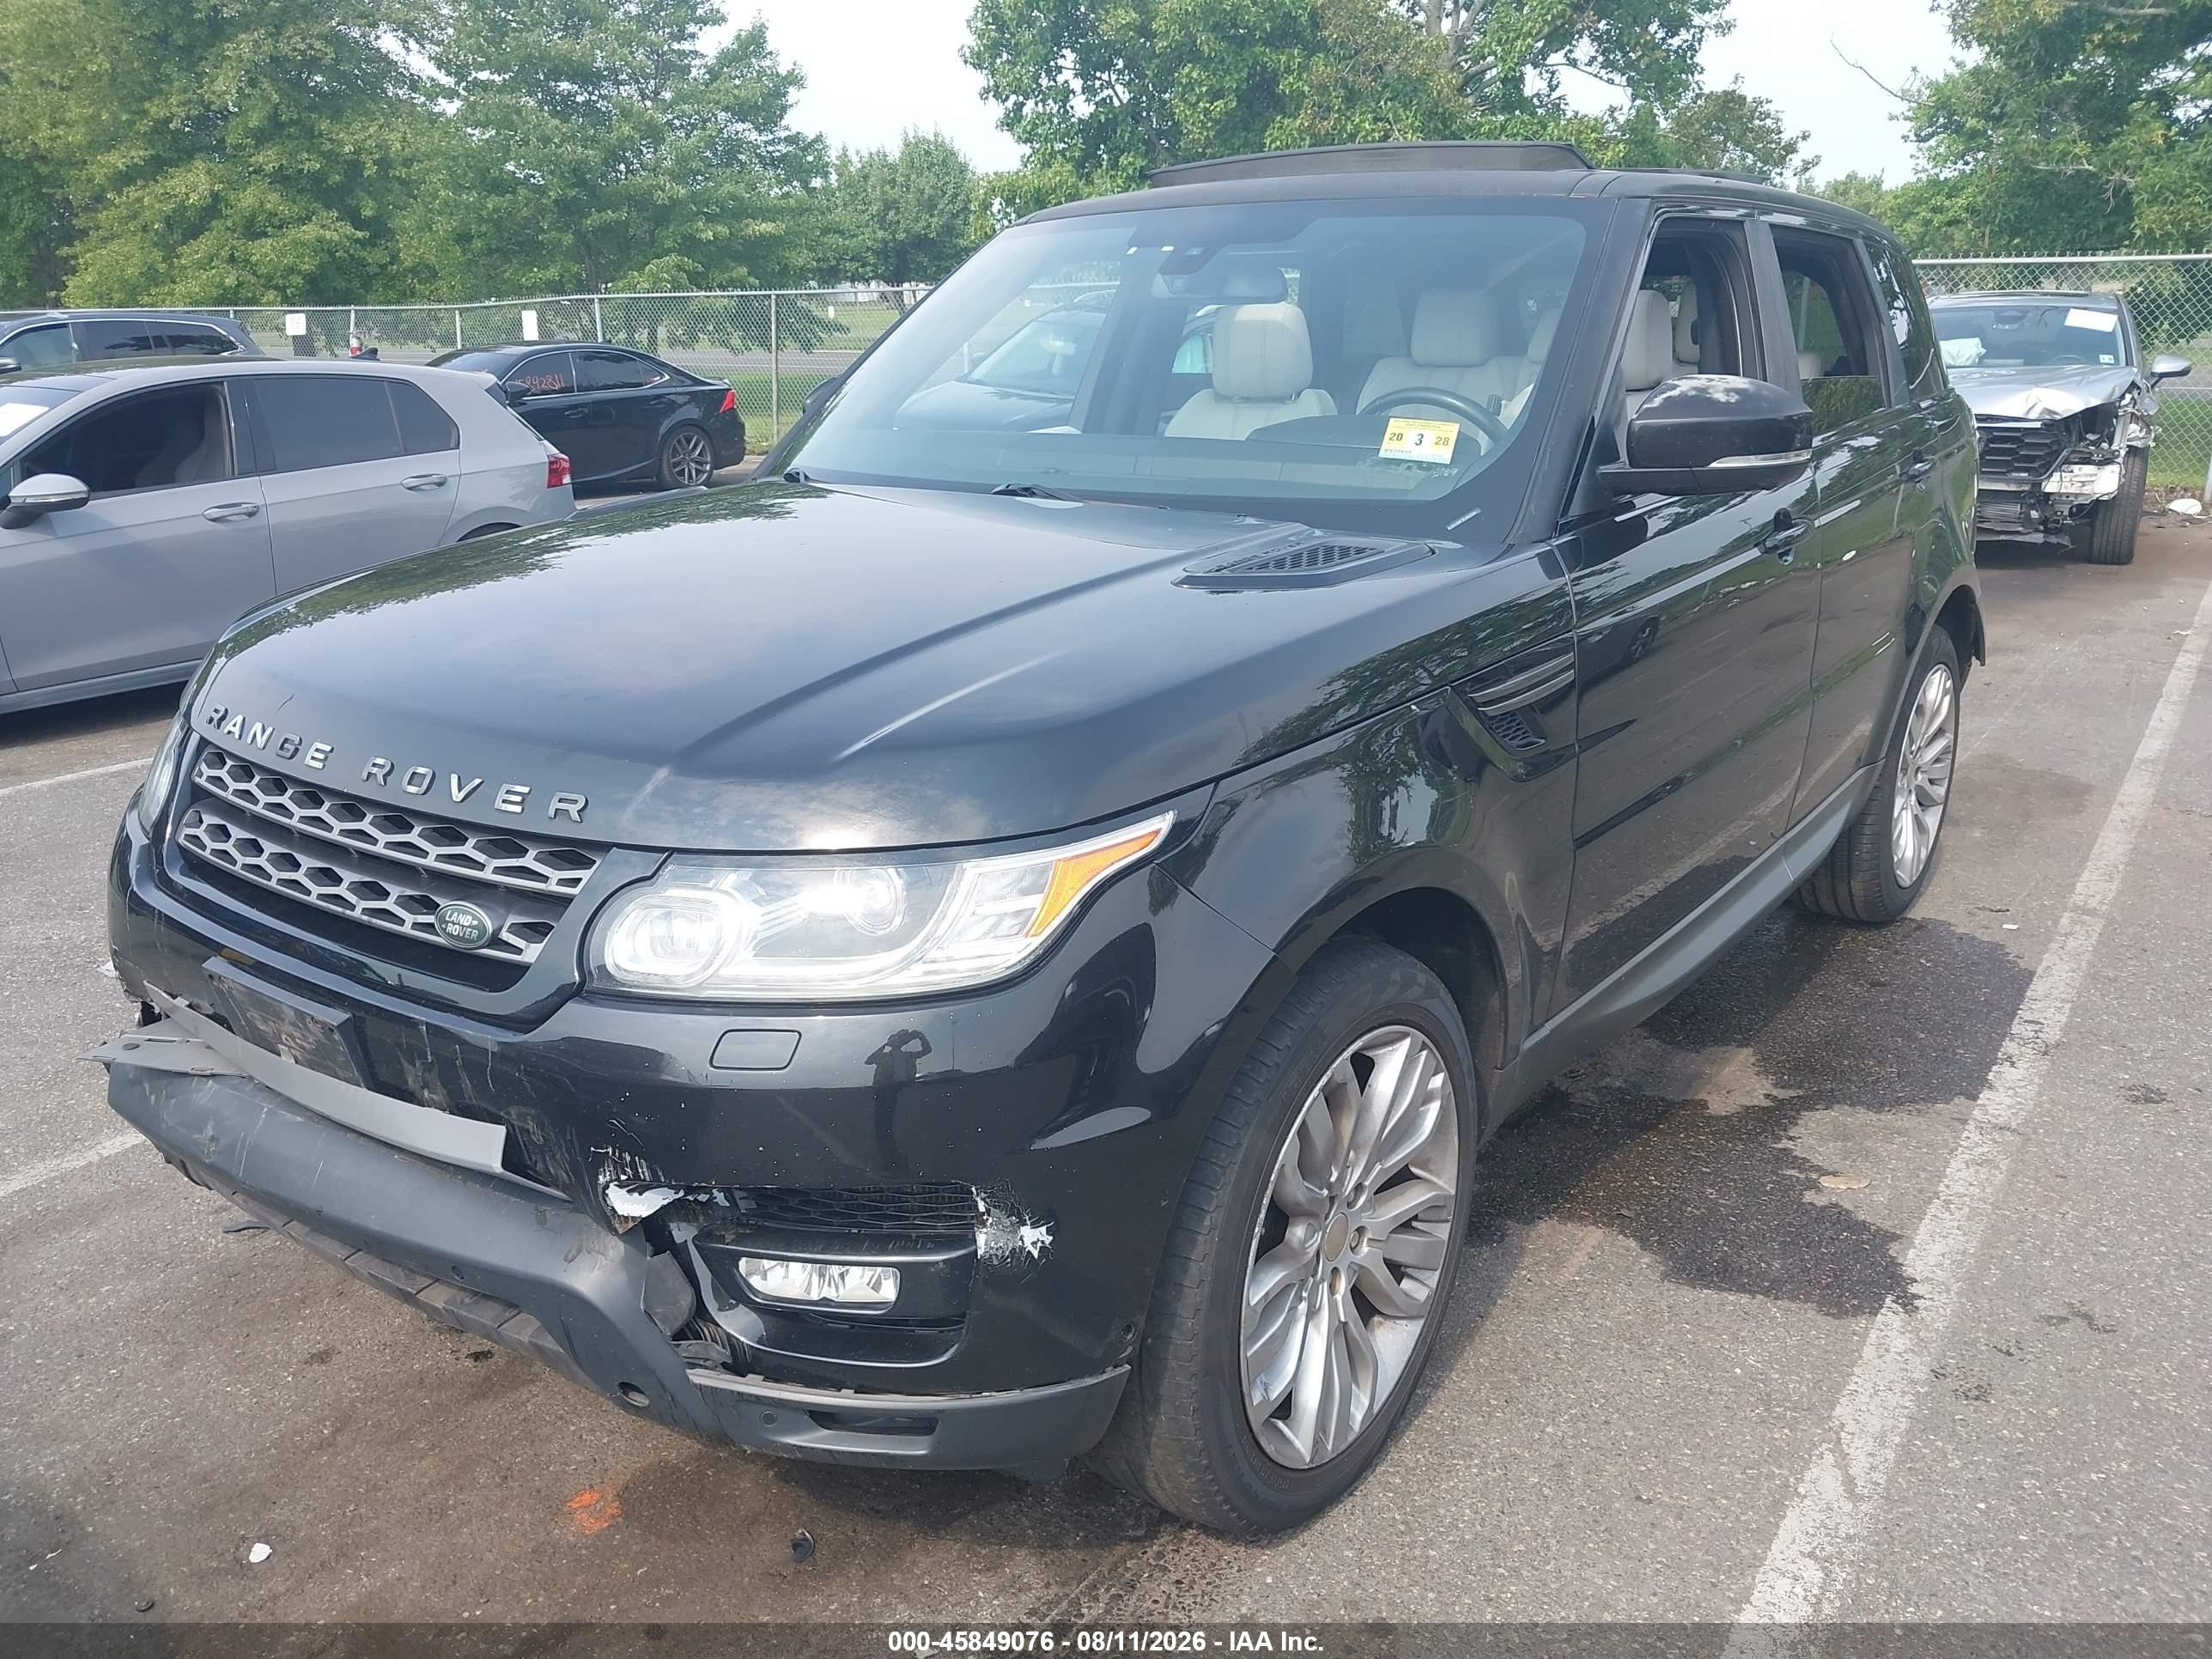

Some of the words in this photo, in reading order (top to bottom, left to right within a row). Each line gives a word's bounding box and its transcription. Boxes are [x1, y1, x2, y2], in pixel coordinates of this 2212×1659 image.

[1389, 432, 1404, 441] 20
[1414, 433, 1425, 446] 3
[1434, 435, 1450, 446] 28
[206, 703, 334, 769] RANGE
[361, 757, 589, 823] ROVER
[445, 910, 473, 927] LAND
[446, 922, 479, 941] ROVER
